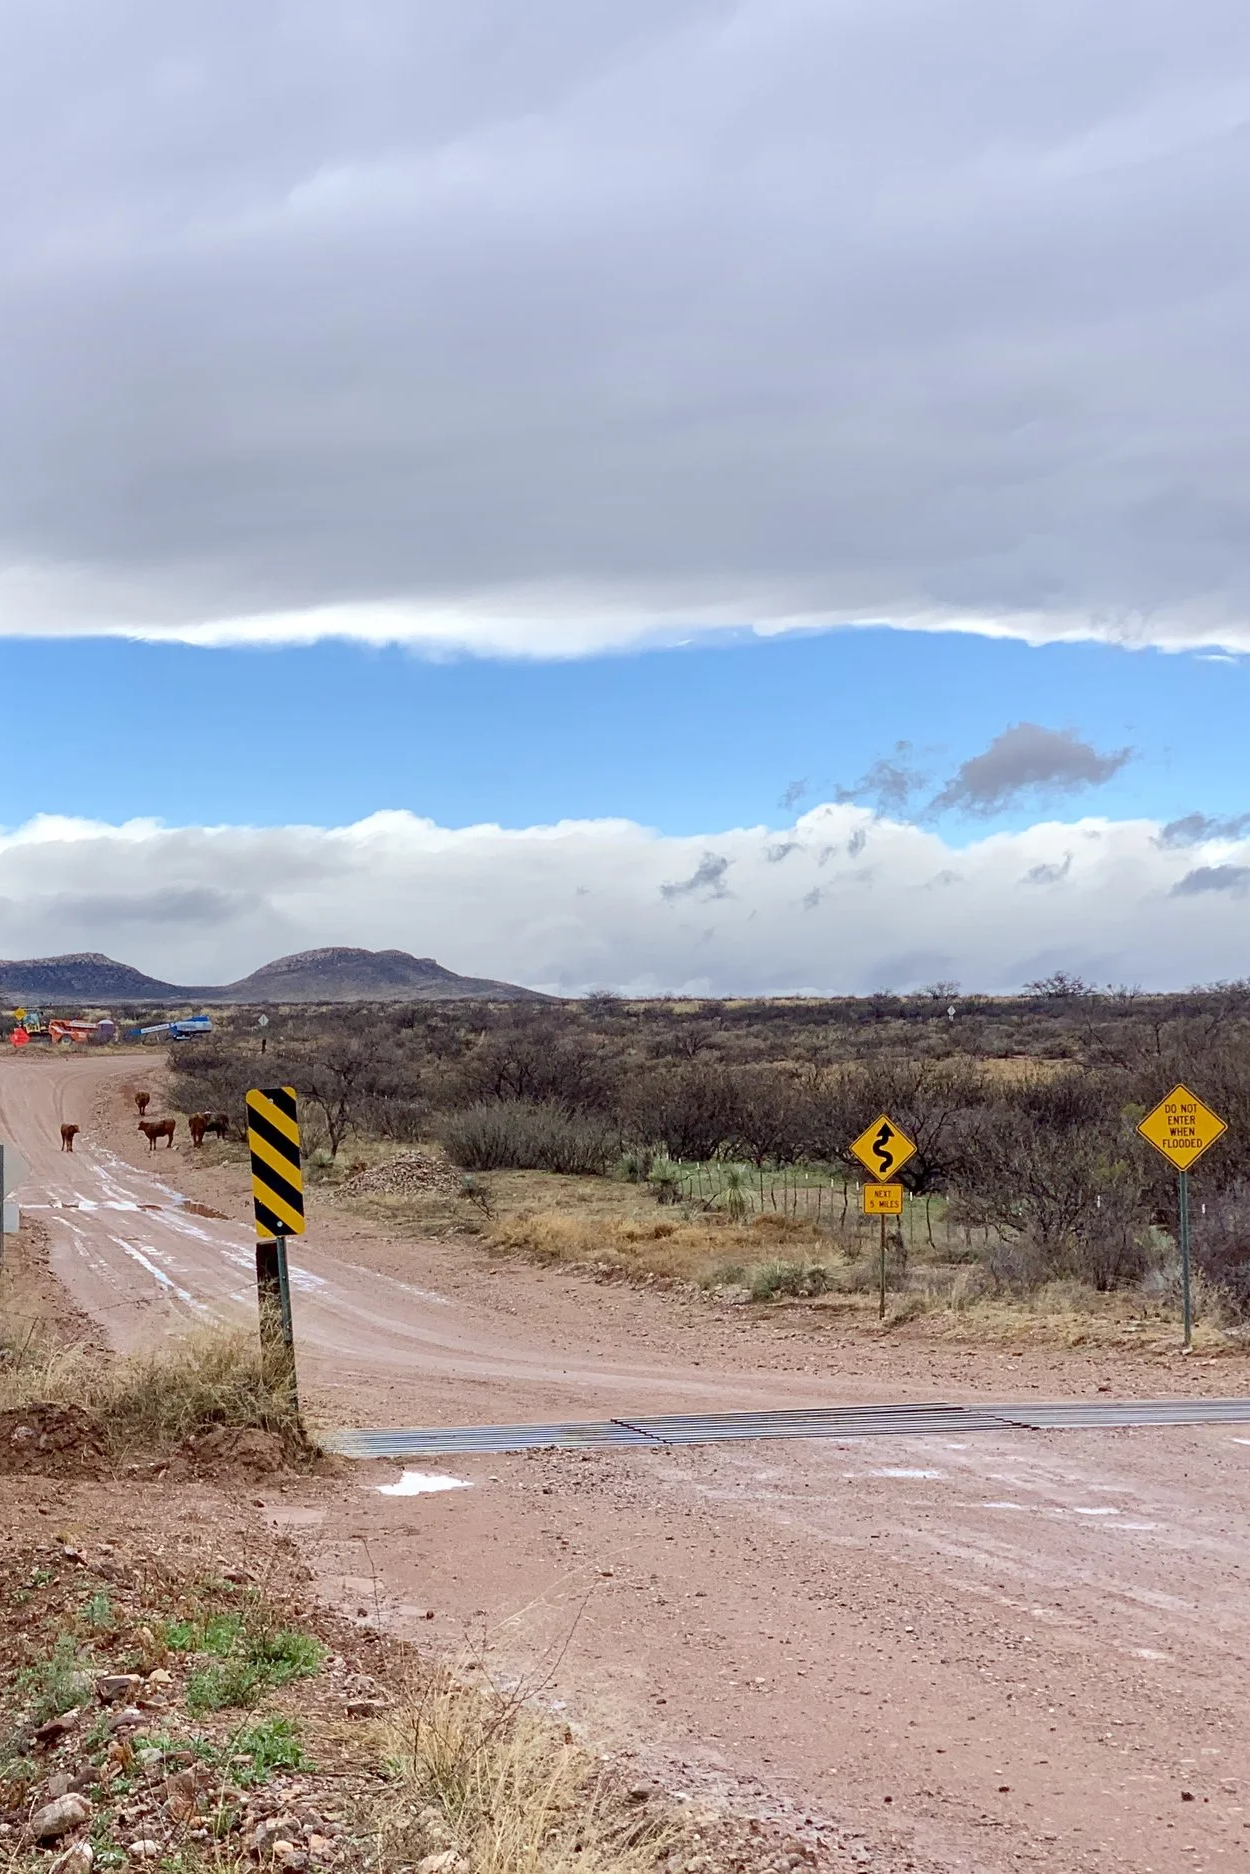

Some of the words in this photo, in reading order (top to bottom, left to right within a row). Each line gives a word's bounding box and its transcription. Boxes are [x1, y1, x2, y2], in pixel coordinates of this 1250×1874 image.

[1164, 1104, 1177, 1113] DO
[1181, 1104, 1197, 1113] NOT
[1167, 1115, 1196, 1125] ENTER
[1169, 1127, 1195, 1136] WHEN
[1162, 1139, 1203, 1148] FLOODED
